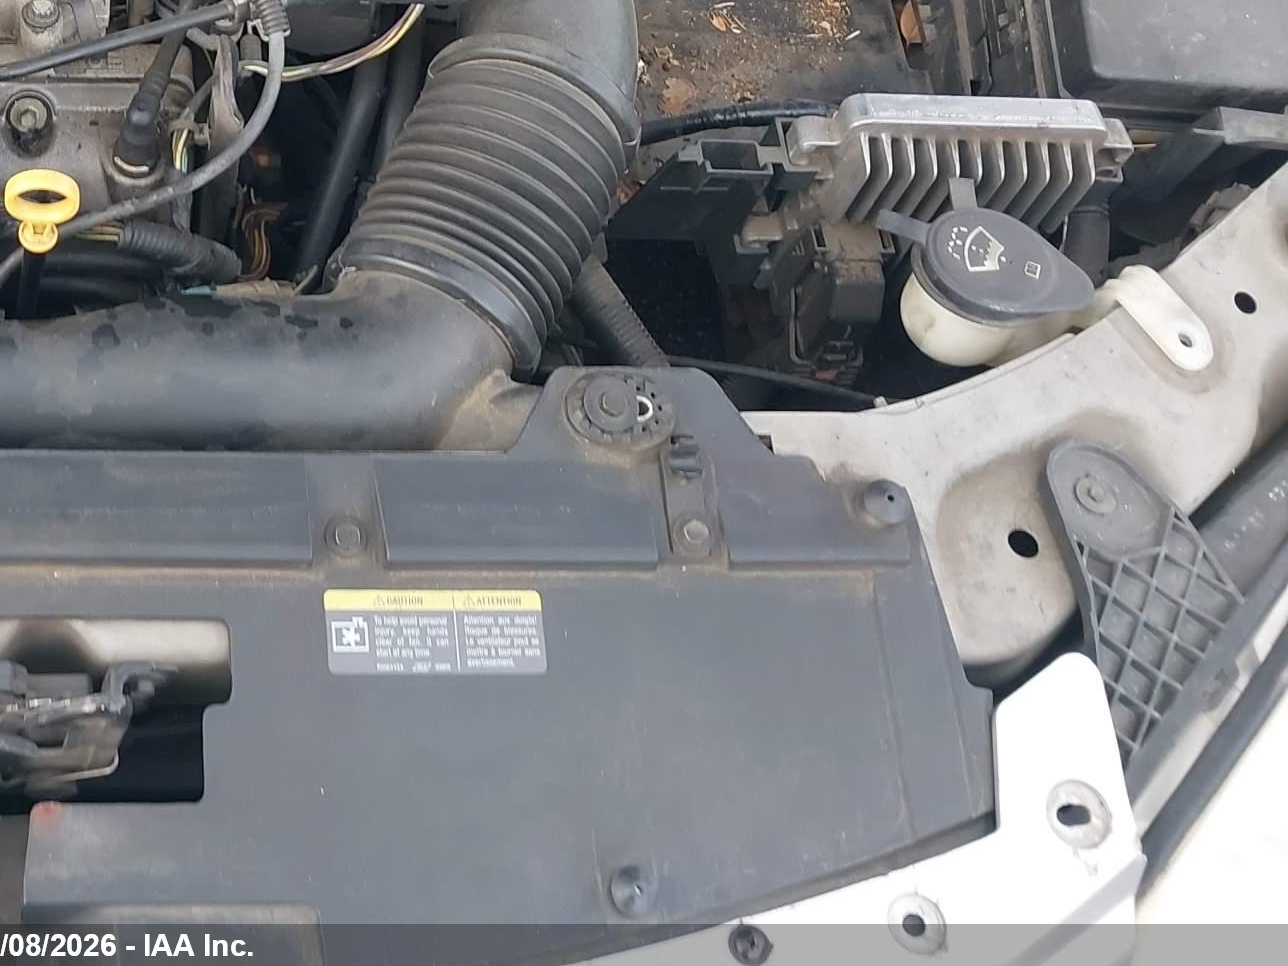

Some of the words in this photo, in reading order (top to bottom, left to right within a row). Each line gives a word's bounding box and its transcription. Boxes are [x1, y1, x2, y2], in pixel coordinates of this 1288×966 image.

[387, 596, 423, 606] CAUTION
[477, 596, 522, 606] ATTENTION
[374, 615, 382, 626] To
[383, 615, 398, 626] help
[399, 615, 417, 626] avoid
[418, 616, 448, 627] personal
[464, 614, 494, 625] Attention
[498, 616, 510, 625] aux
[402, 626, 420, 637] keep
[427, 626, 448, 637] hands
[491, 626, 500, 636] de
[375, 637, 392, 647] clear
[397, 637, 404, 647] of
[436, 638, 449, 647] can
[465, 636, 474, 646] Le
[477, 636, 511, 646] ventilateur
[513, 637, 529, 647] peut
[531, 637, 540, 646] se
[376, 647, 392, 658] start
[392, 647, 400, 658] at
[401, 648, 413, 659] any
[524, 648, 541, 657] sans
